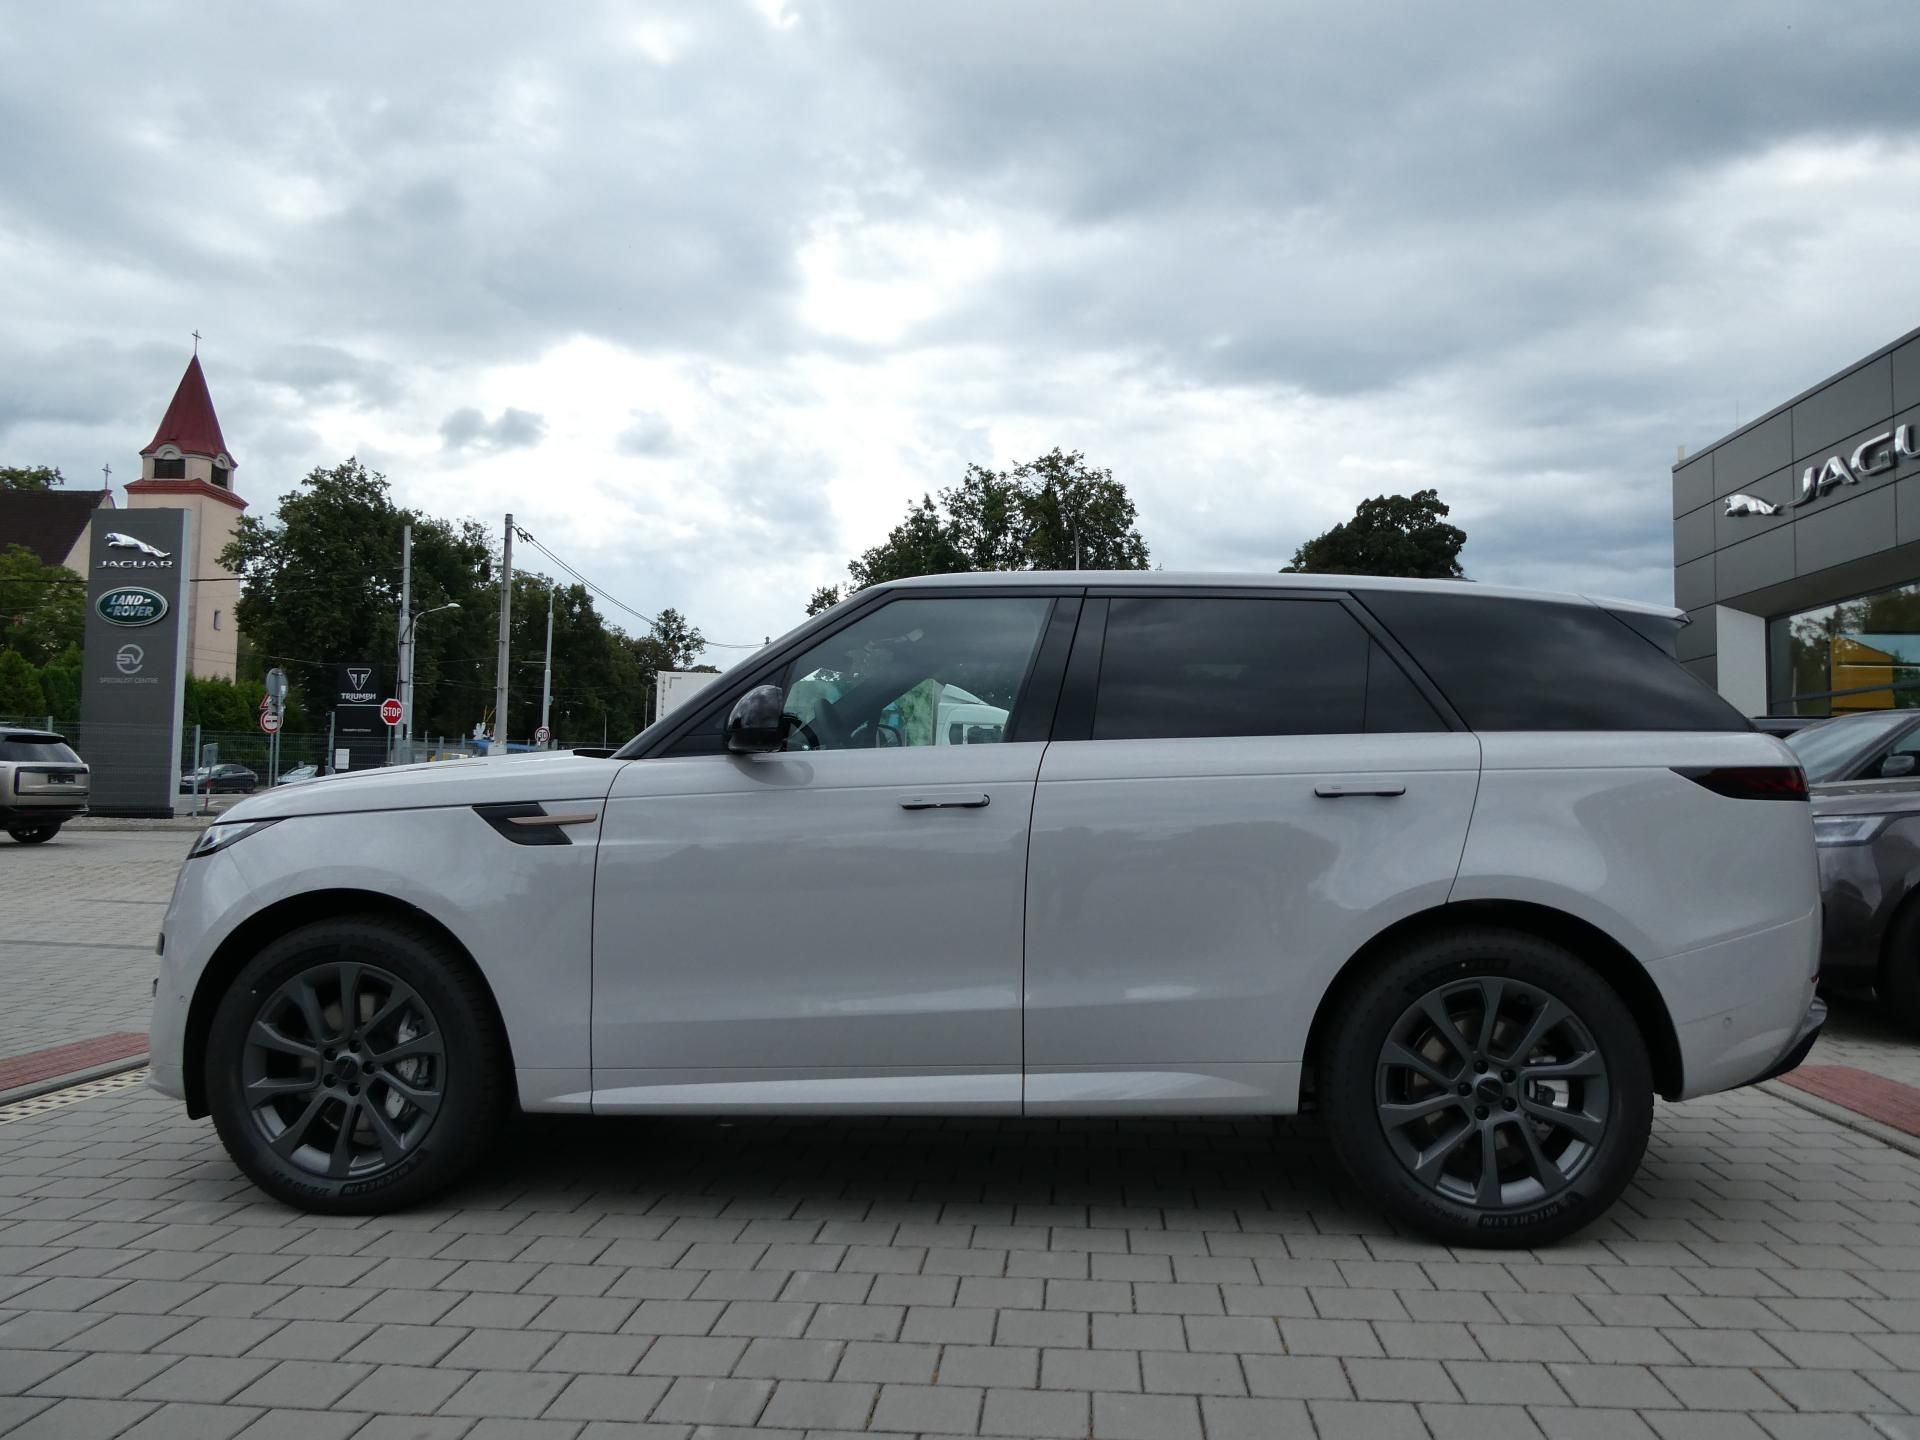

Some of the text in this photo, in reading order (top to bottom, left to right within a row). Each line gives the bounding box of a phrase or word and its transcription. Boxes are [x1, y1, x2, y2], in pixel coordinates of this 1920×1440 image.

[96, 560, 173, 568] JAGUAR
[110, 594, 144, 605] LAND
[112, 606, 154, 617] ROVER
[341, 693, 377, 702] TRIUMPH
[383, 706, 402, 717] STOP
[538, 731, 548, 740] 30
